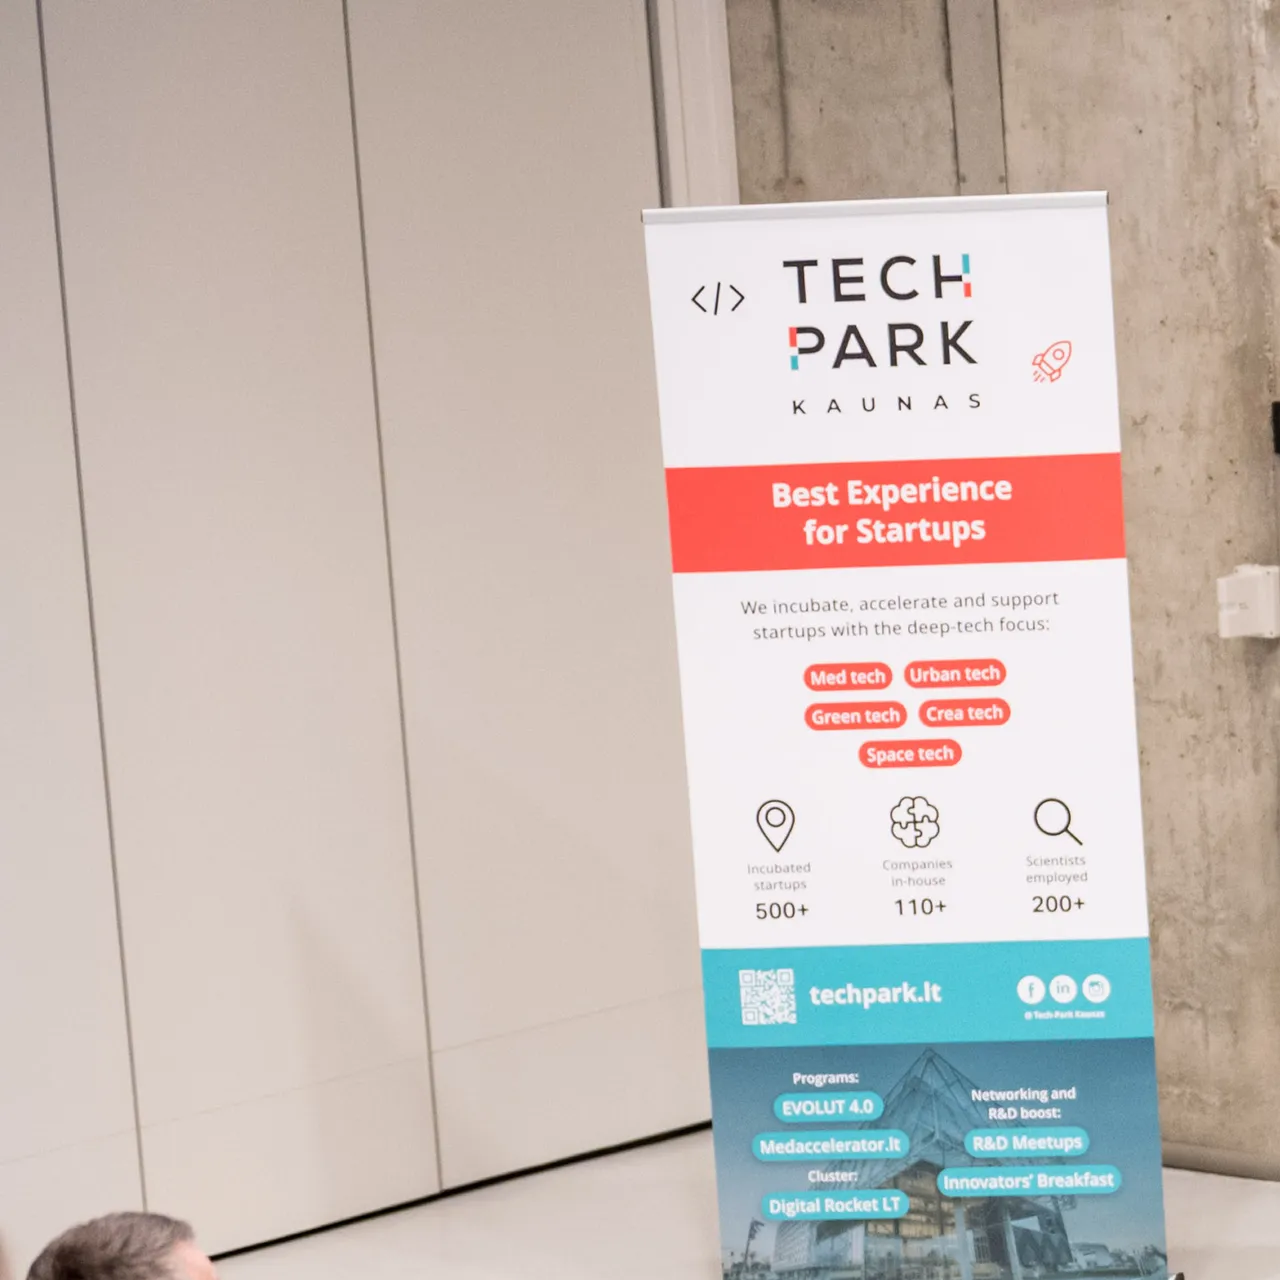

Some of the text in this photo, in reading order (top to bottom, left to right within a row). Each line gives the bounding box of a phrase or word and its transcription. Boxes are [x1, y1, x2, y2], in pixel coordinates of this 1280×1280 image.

[782, 253, 973, 304] TECH
[788, 320, 978, 371] PARK
[792, 393, 981, 415] KAUNAS
[771, 477, 1013, 511] Best Experience
[803, 516, 986, 548] for Startups
[740, 591, 1060, 615] We incubate, accelerate and support
[753, 616, 1051, 641] startups with the deep-tech focus:
[810, 667, 886, 686] Med tech
[909, 665, 1001, 683] Urban tech
[811, 706, 901, 725] Green tech
[925, 703, 1004, 722] Crea tech
[866, 744, 954, 766] Space tech
[747, 861, 811, 875] Incubated
[882, 858, 953, 872] Companies
[1025, 854, 1086, 868] Scientists
[753, 878, 807, 892] startups
[891, 874, 946, 887] in-house
[1025, 870, 1088, 885] employed
[755, 901, 809, 920] 500+
[894, 898, 947, 916] 110+
[1032, 895, 1085, 913] 200+
[809, 981, 942, 1010] techpark.lt
[792, 1071, 859, 1086] Programs:
[971, 1086, 1076, 1104] Networking and
[782, 1099, 874, 1116] EVOLUT 4.0
[988, 1106, 1061, 1120] R&D boost:
[759, 1138, 901, 1155] Medaccelerator.lt
[972, 1134, 1082, 1153] R&D Meetups
[807, 1169, 858, 1182] Cluster:
[1037, 1171, 1114, 1188] Breakfast
[768, 1196, 900, 1217] Digital Rocket LT
